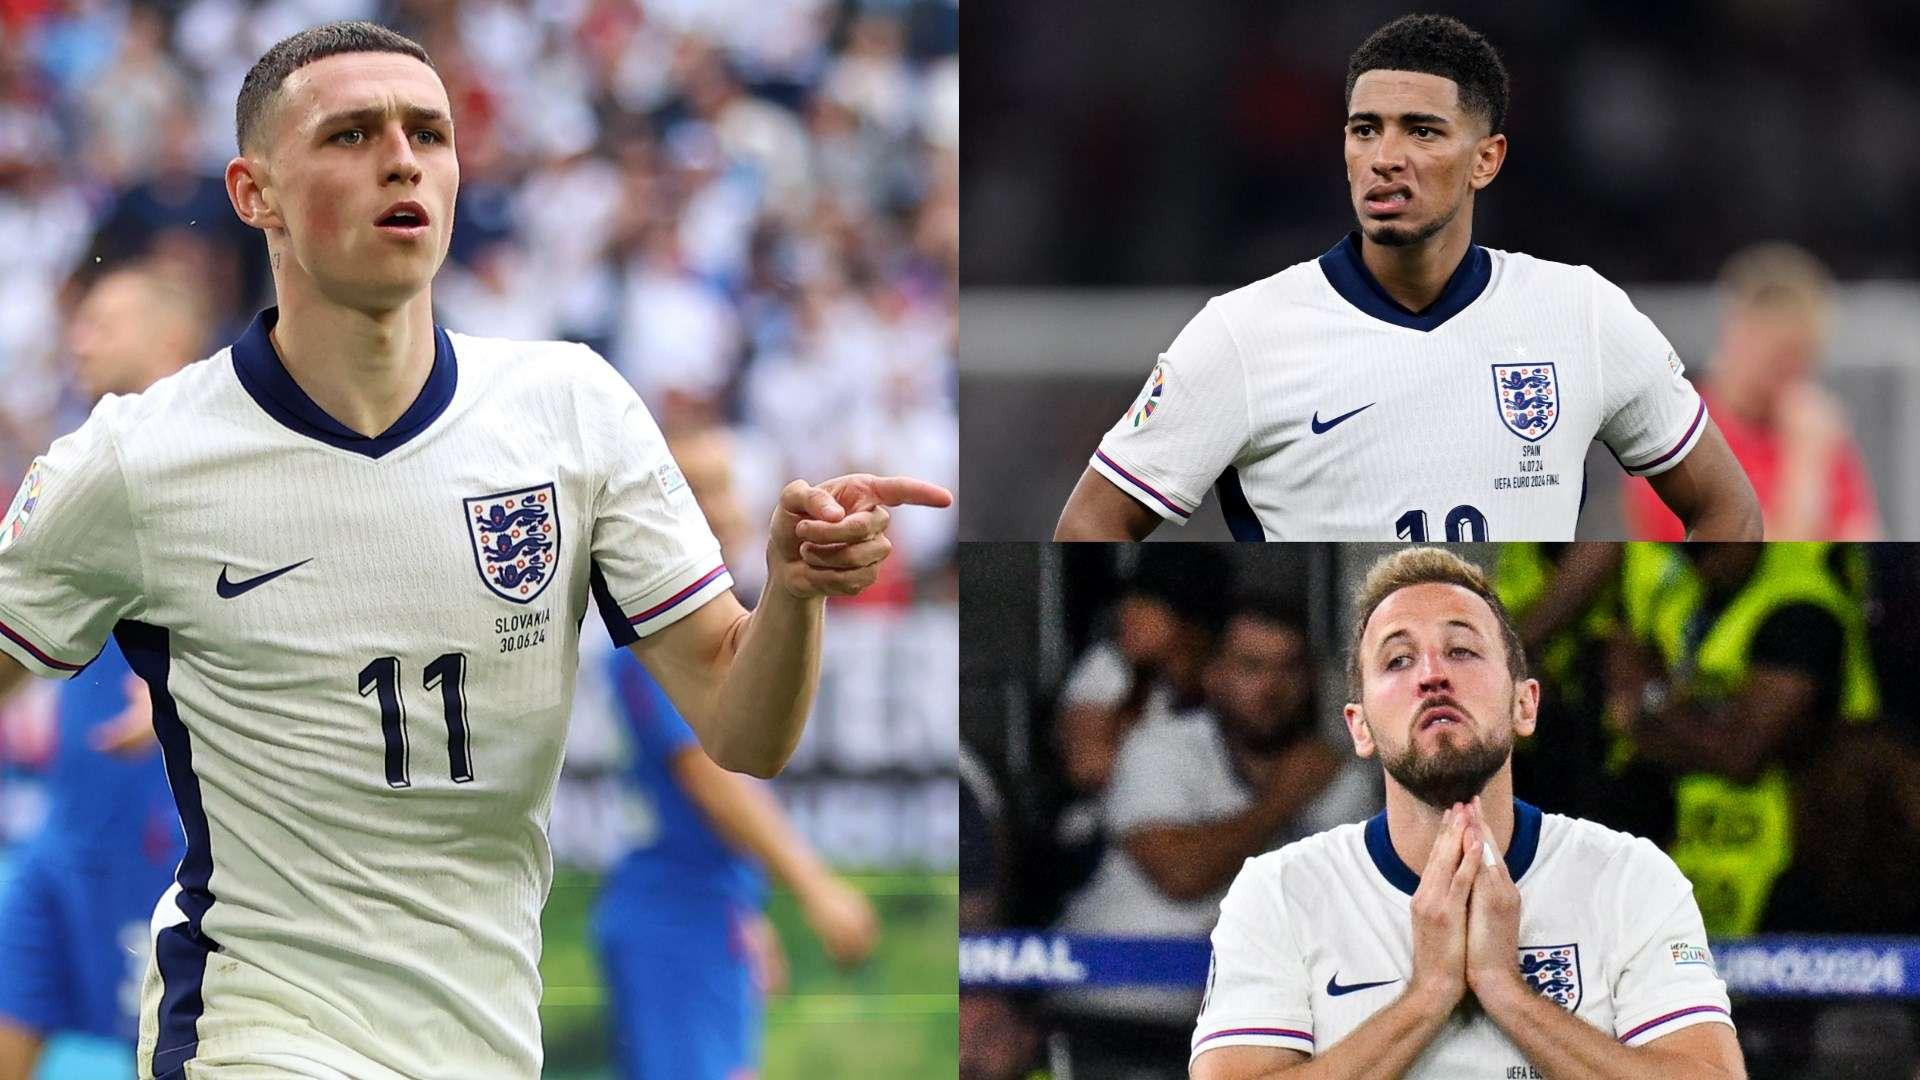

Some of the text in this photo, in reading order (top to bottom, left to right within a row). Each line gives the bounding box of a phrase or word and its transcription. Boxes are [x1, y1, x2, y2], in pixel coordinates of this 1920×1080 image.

[1522, 444, 1541, 457] SPAIN
[1494, 473, 1560, 490] UEFA EURO 2024 FINAL
[495, 607, 550, 634] SLOVAKIA
[500, 629, 545, 653] 30.06.24
[358, 653, 474, 789] 11
[1506, 1065, 1528, 1080] UEFA
